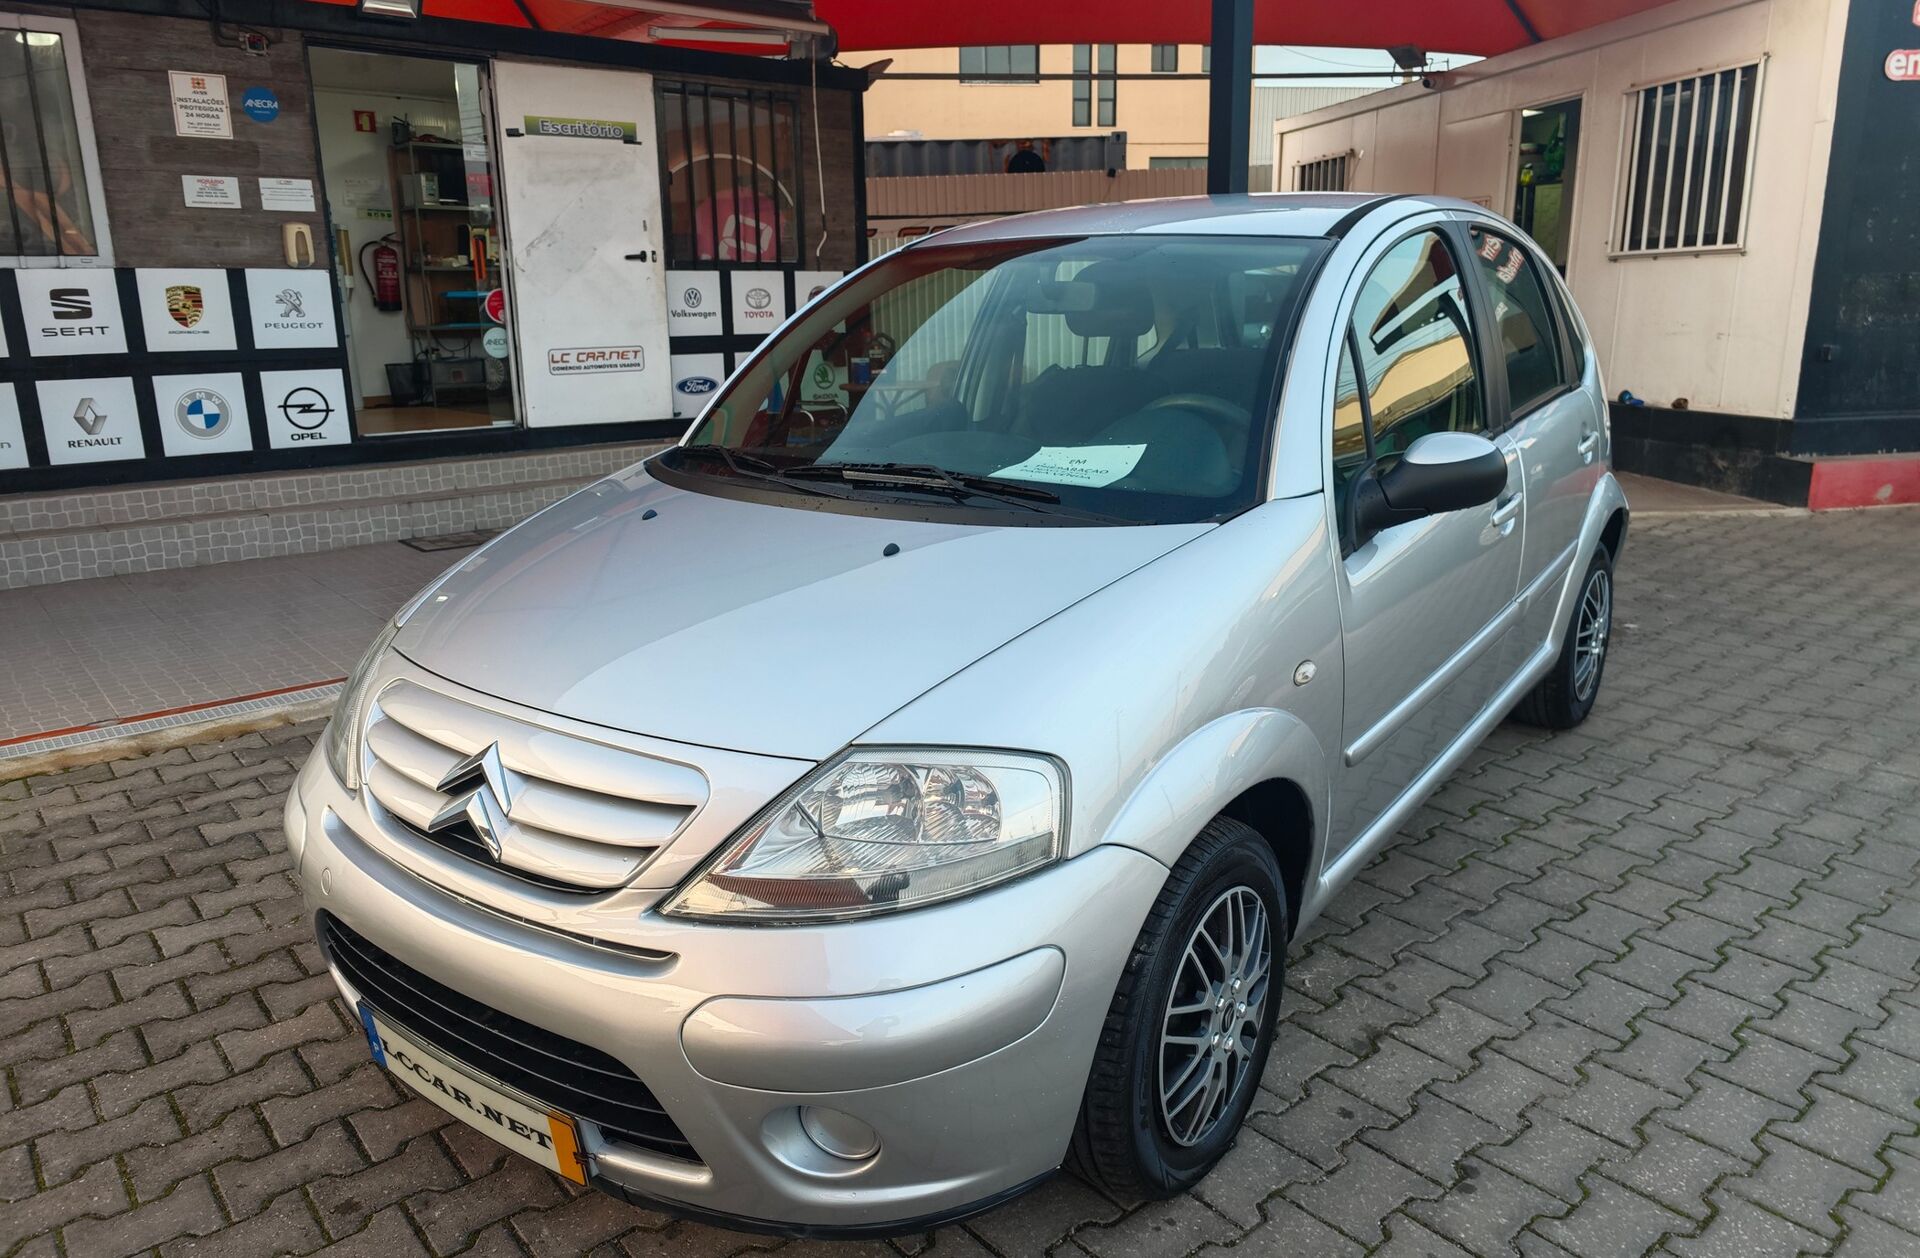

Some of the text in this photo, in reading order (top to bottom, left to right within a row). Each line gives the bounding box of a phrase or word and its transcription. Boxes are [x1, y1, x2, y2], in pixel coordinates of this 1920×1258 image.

[176, 97, 225, 106] INSTALAÇÕES
[244, 98, 279, 109] ANECRA
[179, 104, 224, 113] PROTEGIDAS
[538, 118, 625, 138] Escritório
[671, 310, 717, 319] Volkswagen
[744, 310, 775, 319] TOYOTA
[41, 325, 110, 337] SEAT
[264, 321, 324, 330] PEUGEOT
[551, 353, 571, 364] LC
[684, 379, 711, 393] Ford
[182, 391, 223, 407] BMW
[290, 431, 328, 441] OPEL
[67, 436, 124, 449] RENAULT
[380, 1037, 553, 1151] LCCAR.NET
